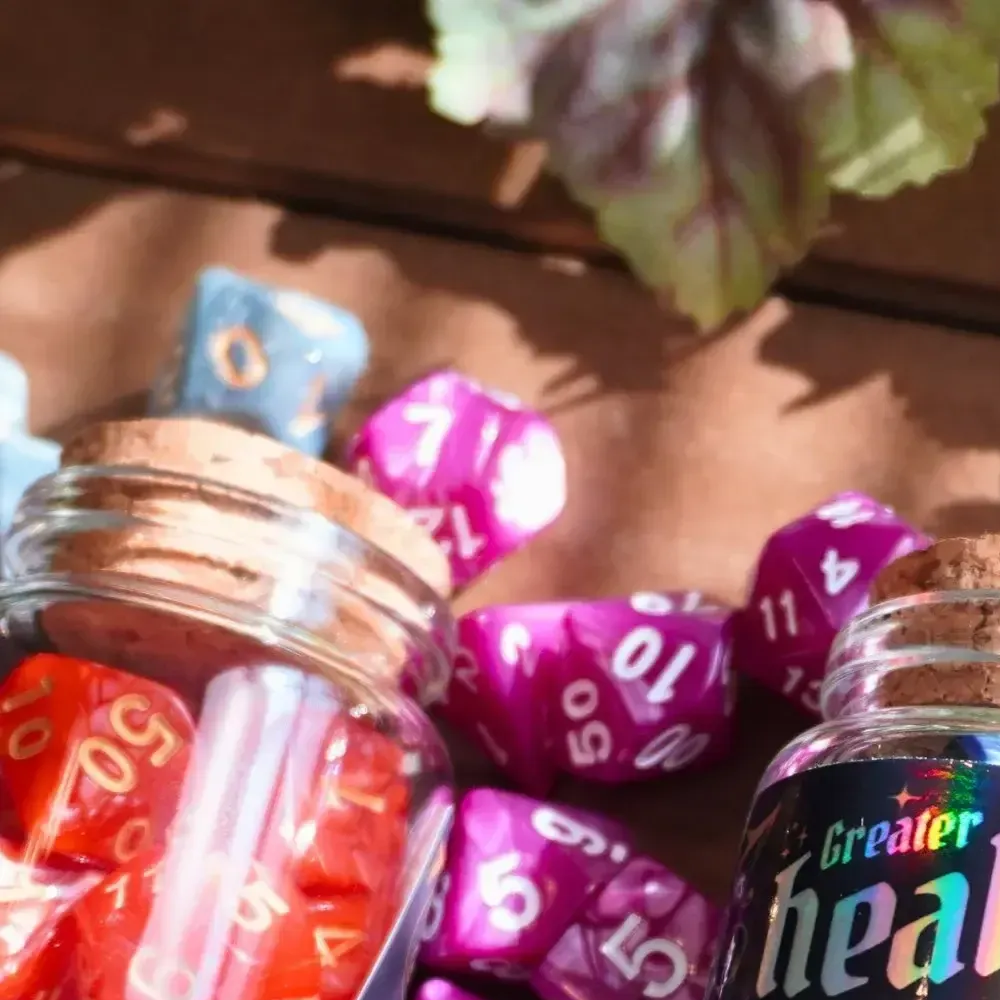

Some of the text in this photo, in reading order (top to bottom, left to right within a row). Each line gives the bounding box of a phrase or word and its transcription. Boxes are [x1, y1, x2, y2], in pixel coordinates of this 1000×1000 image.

[403, 402, 454, 488] 7
[820, 547, 860, 595] 4
[760, 588, 798, 641] 11
[612, 625, 697, 704] 10
[79, 692, 184, 793] 50
[820, 806, 984, 871] Greater
[601, 913, 688, 999] 5
